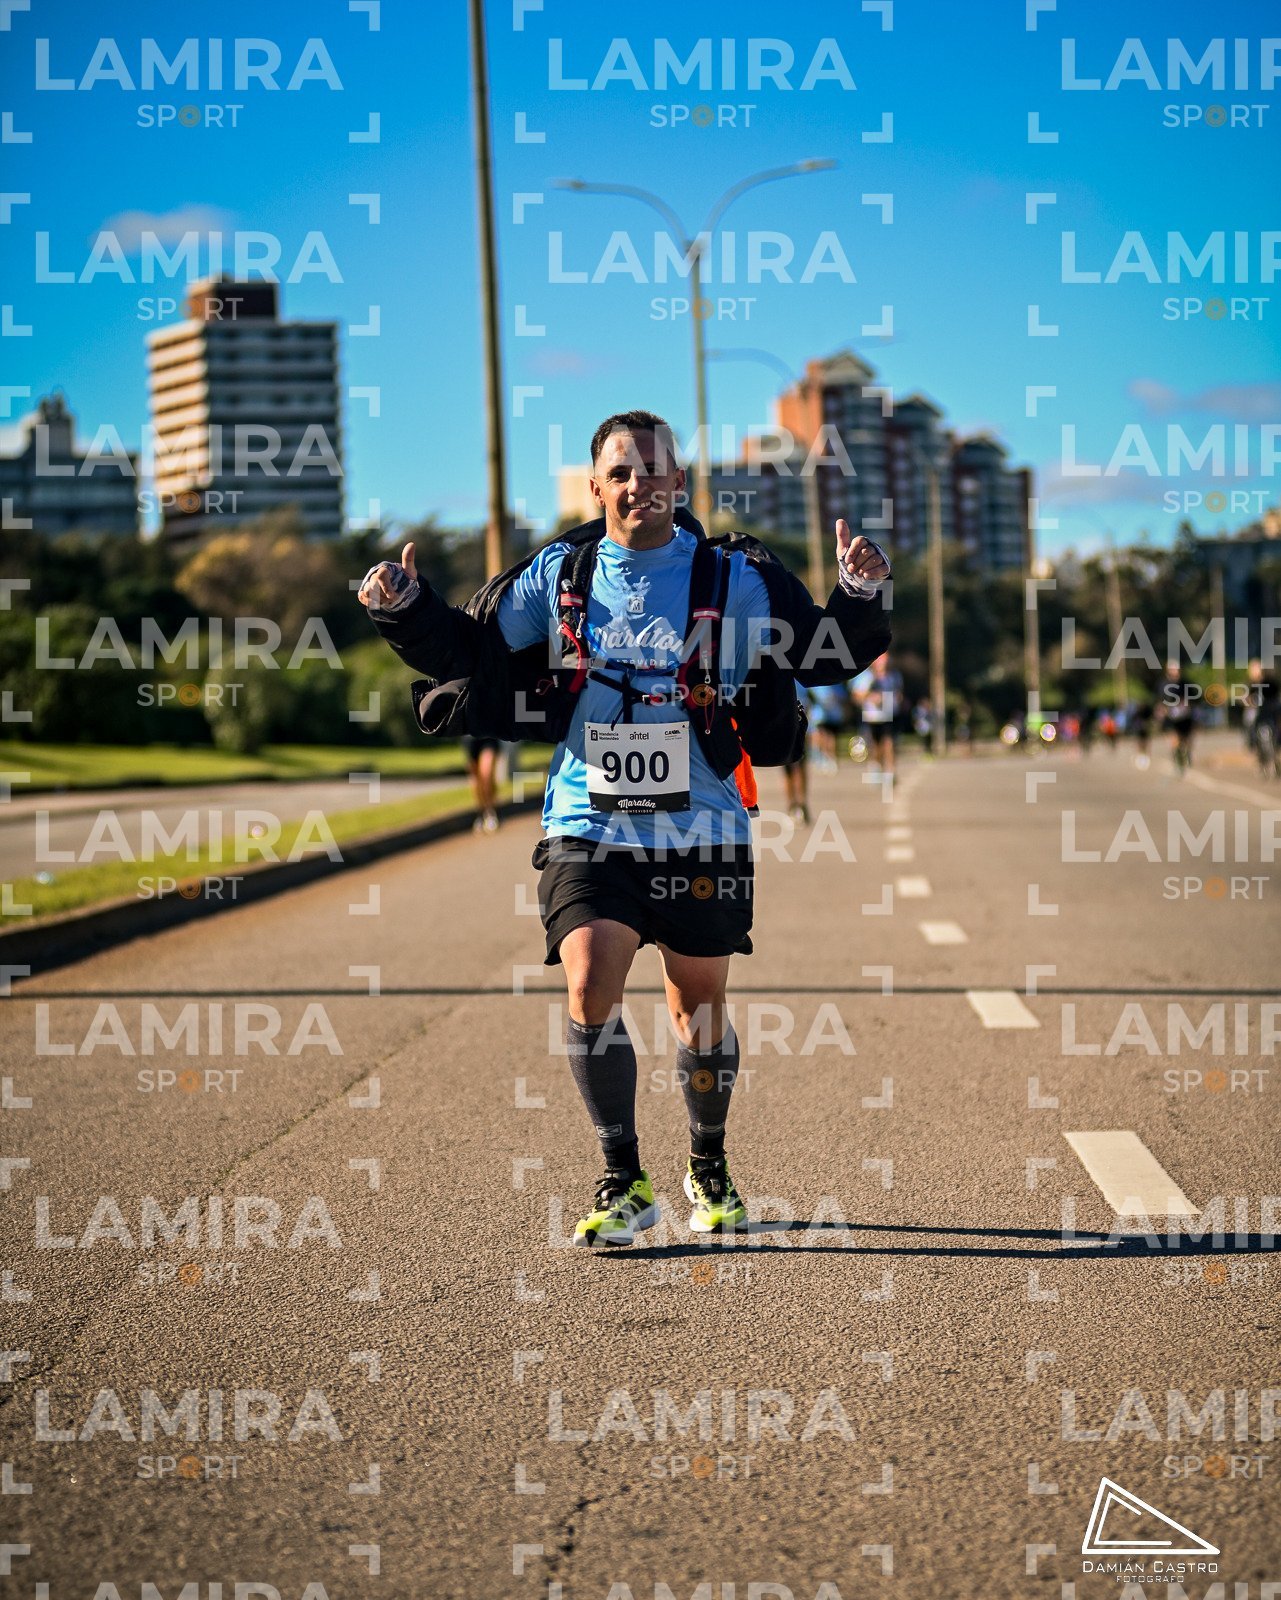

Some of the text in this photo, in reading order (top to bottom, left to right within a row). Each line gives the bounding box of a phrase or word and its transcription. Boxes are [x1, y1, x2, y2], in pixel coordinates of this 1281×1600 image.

[629, 731, 649, 741] antel
[601, 750, 670, 783] 900
[617, 798, 656, 809] Maratón
